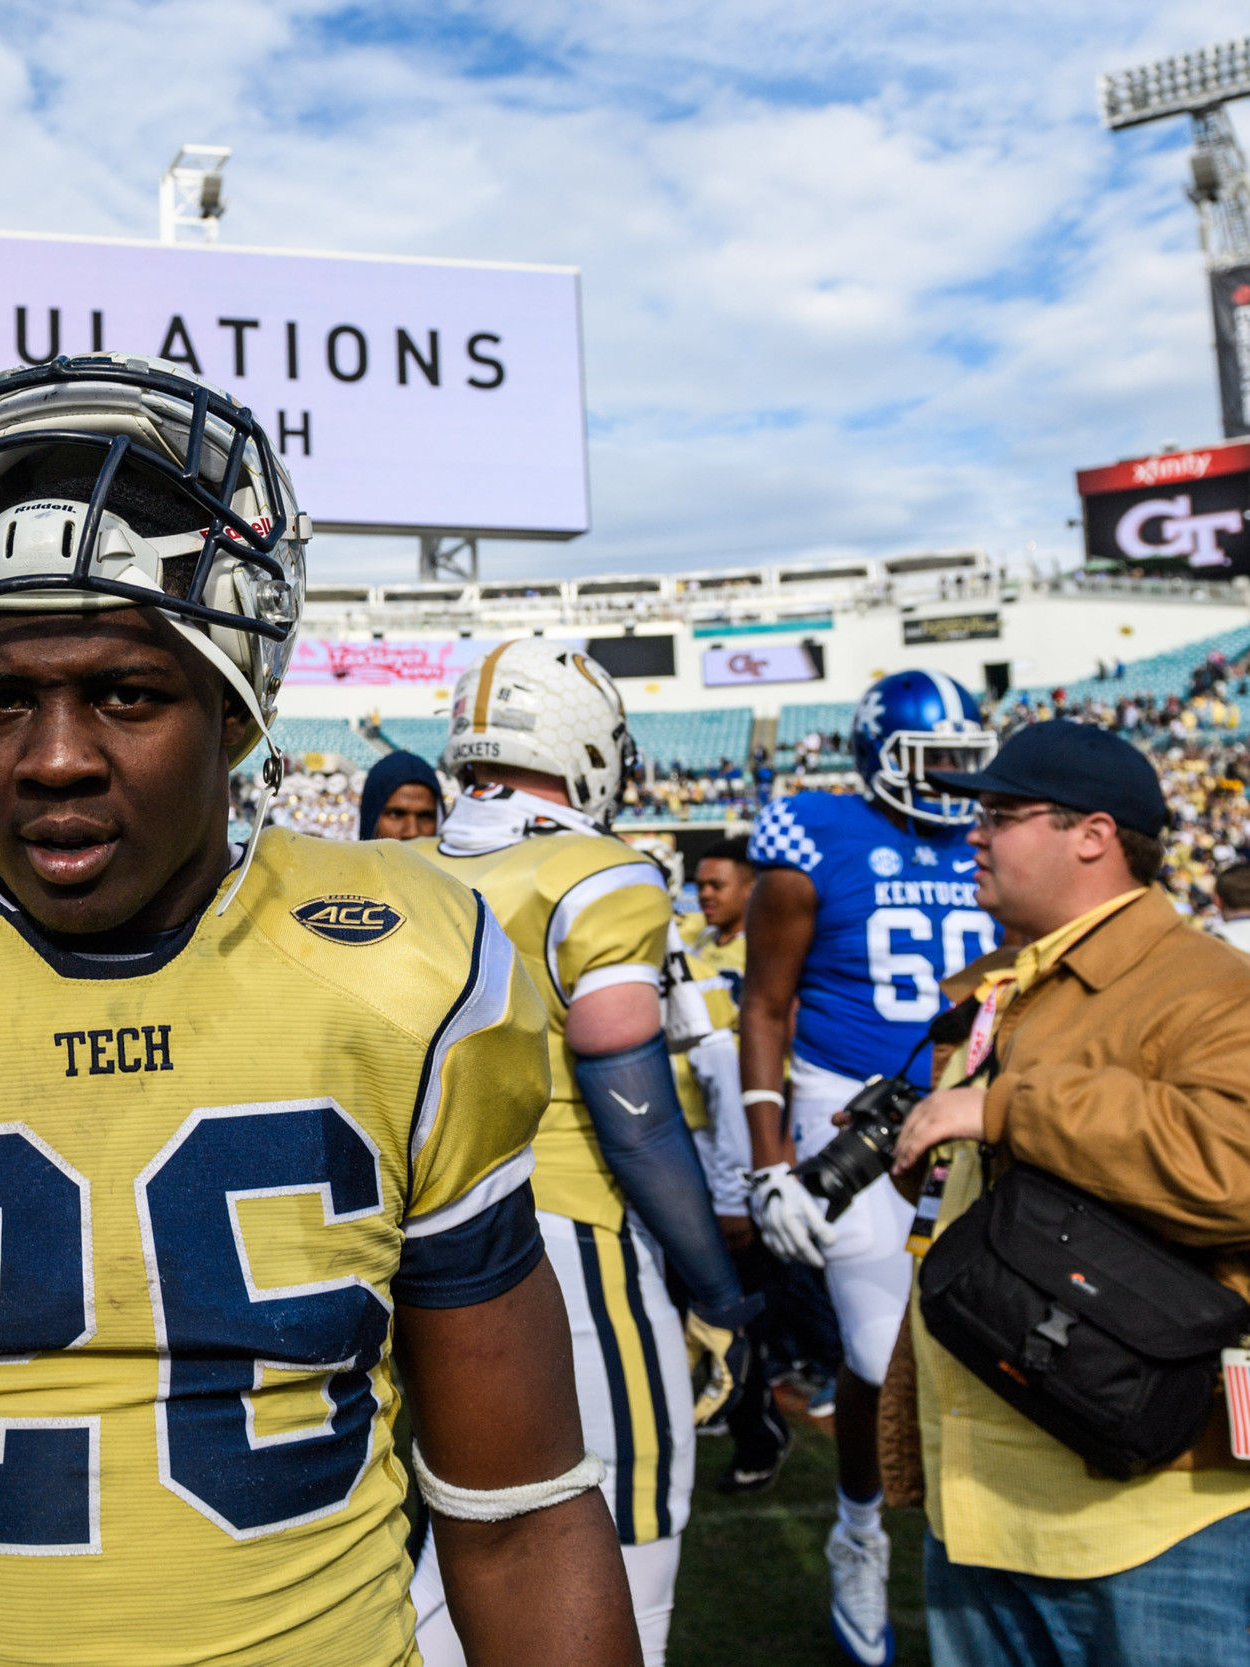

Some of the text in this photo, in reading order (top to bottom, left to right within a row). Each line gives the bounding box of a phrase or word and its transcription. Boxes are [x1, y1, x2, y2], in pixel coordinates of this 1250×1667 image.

[1133, 452, 1212, 486] xfinity
[1115, 493, 1243, 567] GT
[306, 905, 386, 925] ACC
[874, 880, 980, 907] KENTUCK
[866, 907, 999, 1022] 60
[54, 1024, 174, 1077] TECH
